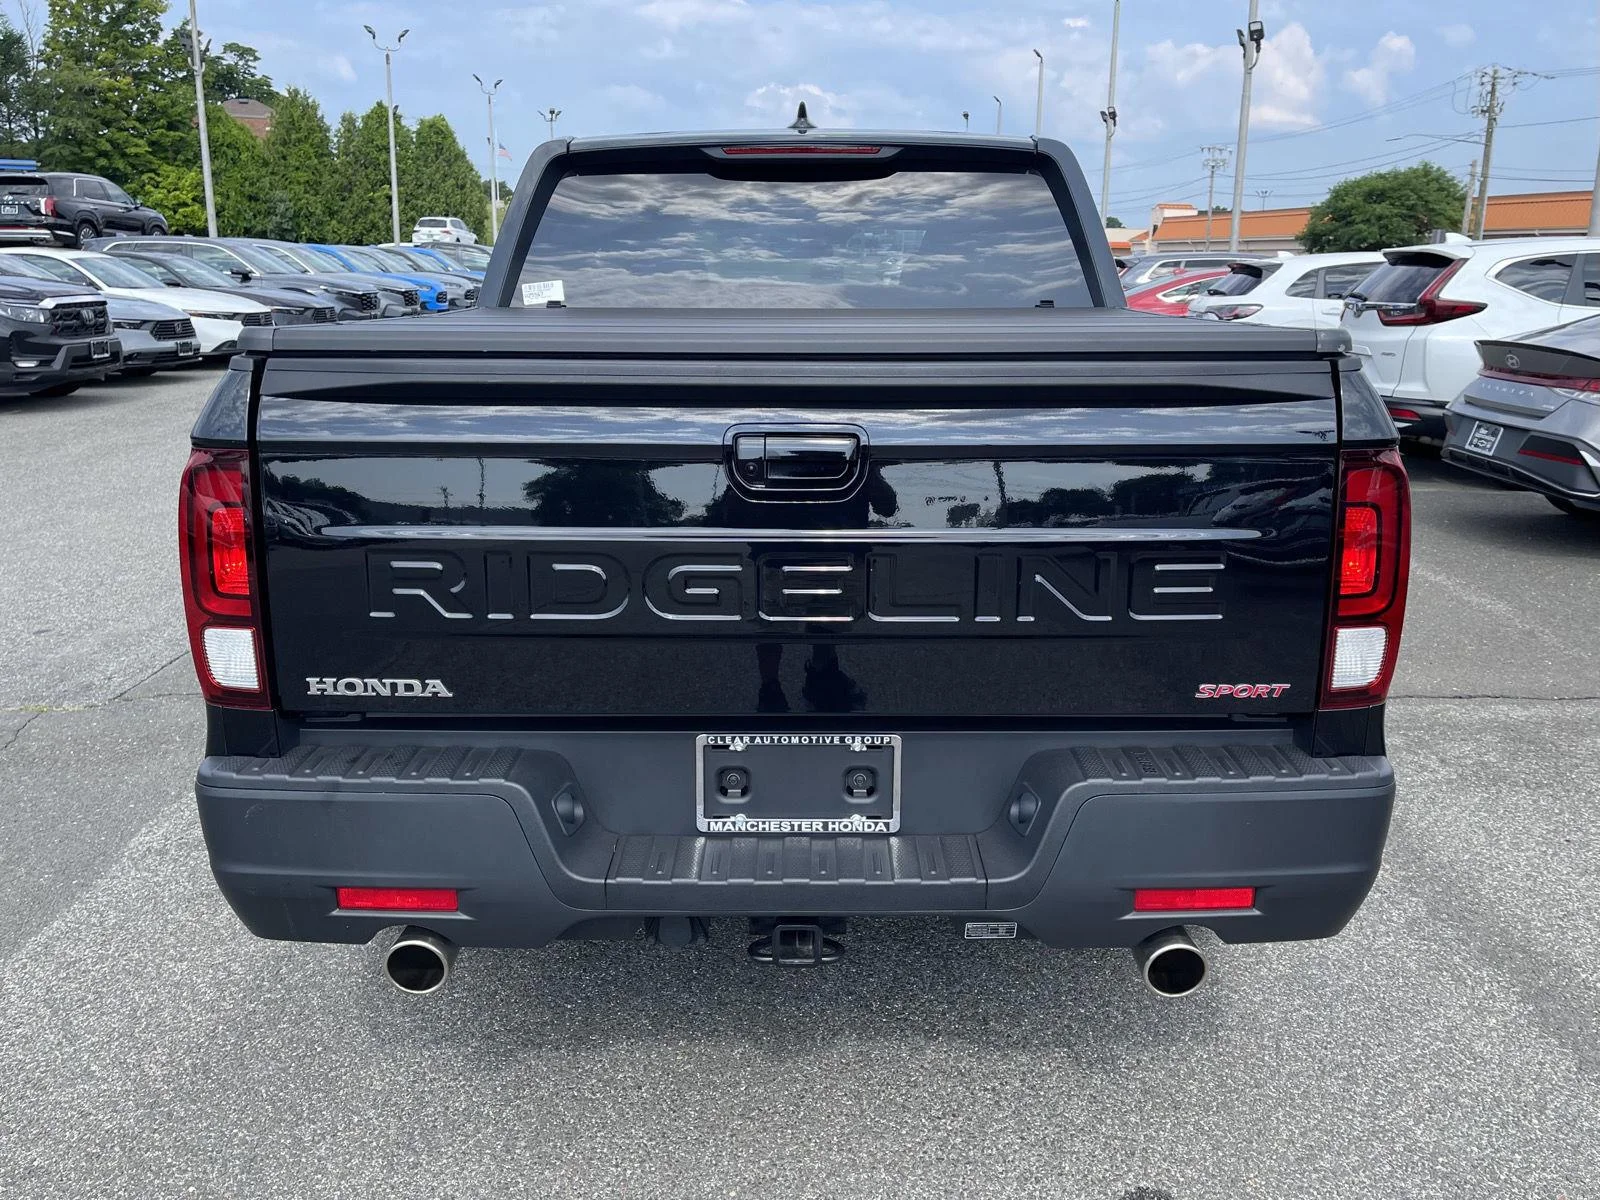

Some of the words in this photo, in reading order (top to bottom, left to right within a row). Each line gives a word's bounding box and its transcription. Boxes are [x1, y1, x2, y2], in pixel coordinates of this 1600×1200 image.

[366, 551, 1226, 622] RIDGELINE
[305, 677, 453, 698] HONDA
[1195, 683, 1291, 698] SPORT
[707, 736, 750, 744] CLEAR
[754, 736, 840, 744] AUTOMOTIVE
[844, 736, 891, 744] GROUP
[709, 821, 824, 832] MANCHESTER
[828, 821, 888, 832] HONDA
